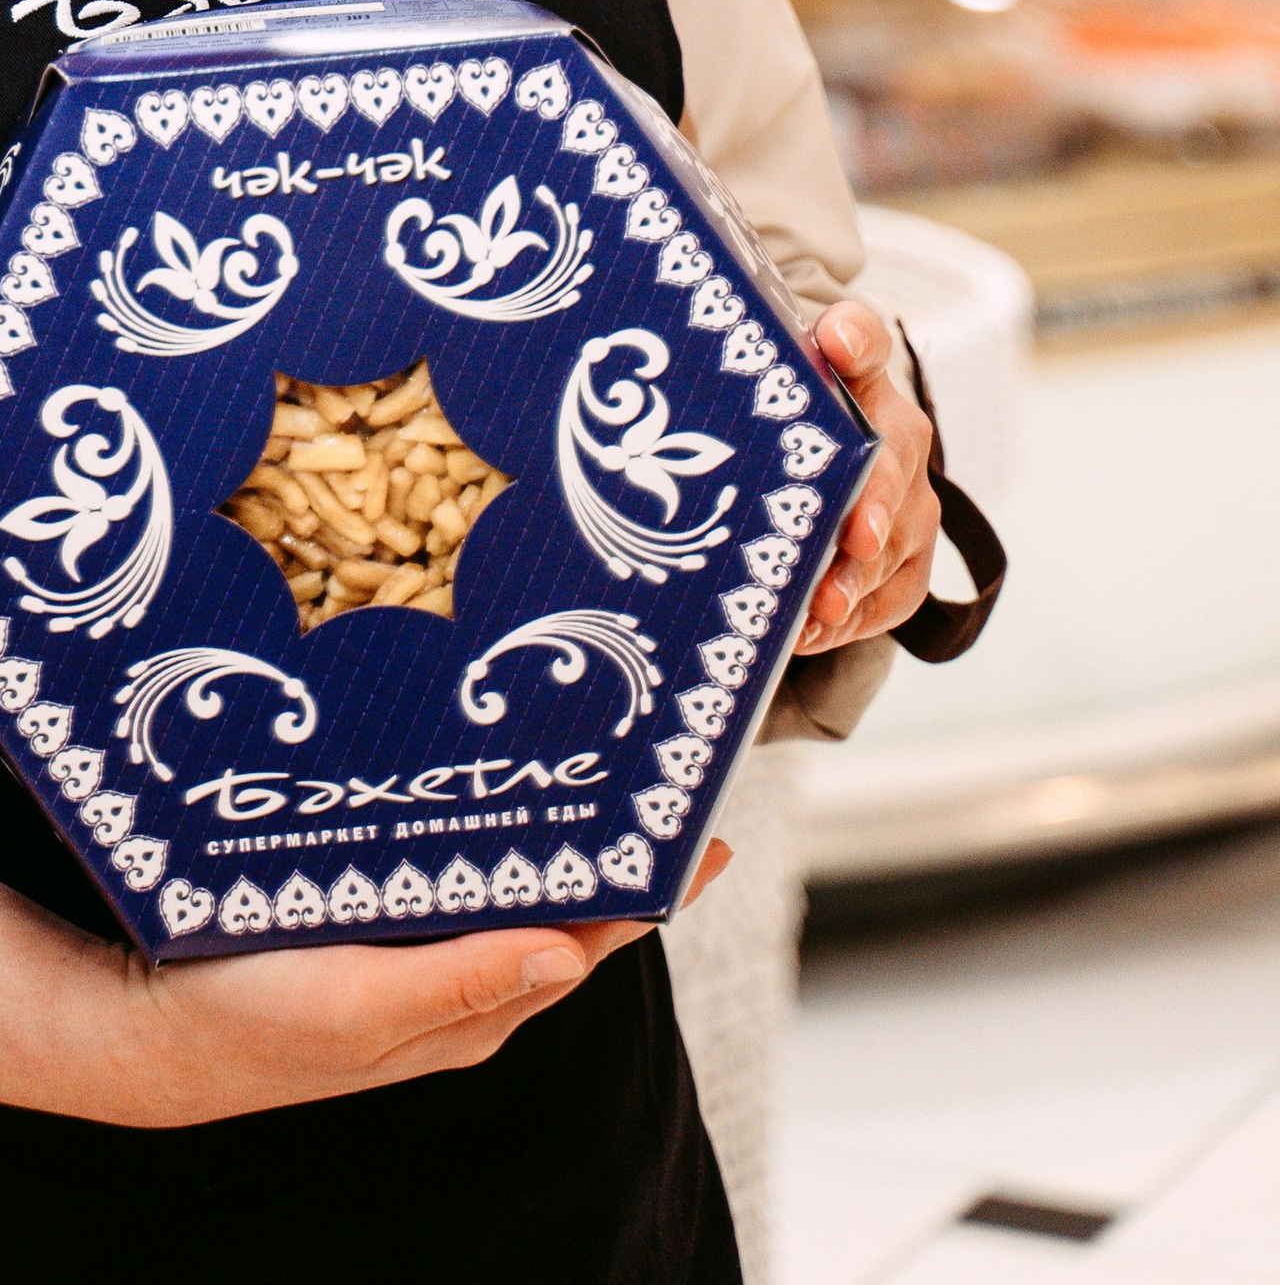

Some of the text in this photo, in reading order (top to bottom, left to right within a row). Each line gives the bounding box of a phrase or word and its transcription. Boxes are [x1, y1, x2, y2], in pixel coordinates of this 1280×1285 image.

[211, 137, 453, 199] чәк-чәк
[207, 802, 597, 855] СУПЕРМАРКЕТ ДОМАШНЕЙ ЕДЫ
